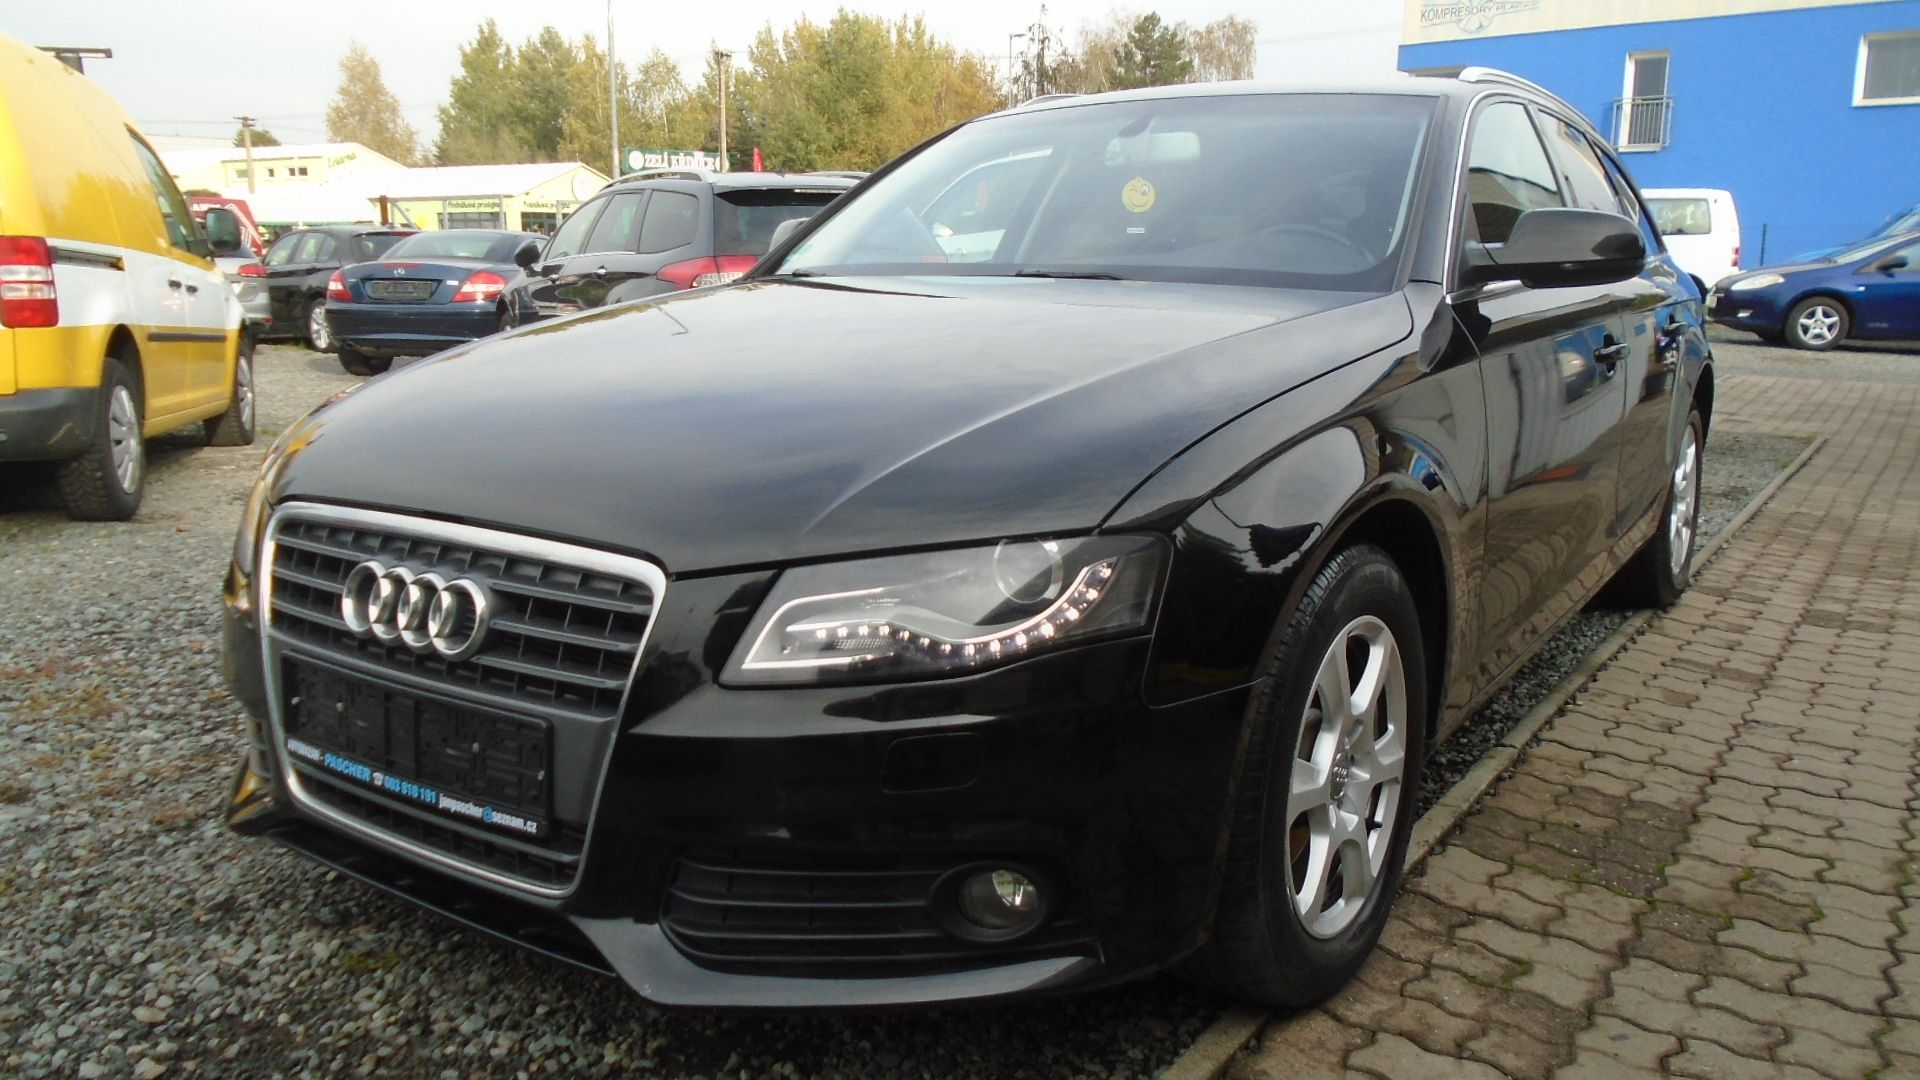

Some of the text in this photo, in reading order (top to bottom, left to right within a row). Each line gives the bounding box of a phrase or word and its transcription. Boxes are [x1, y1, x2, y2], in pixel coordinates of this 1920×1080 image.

[1420, 6, 1492, 22] KOMPRESORY
[324, 752, 371, 782] PASCHER
[420, 787, 437, 804] 191
